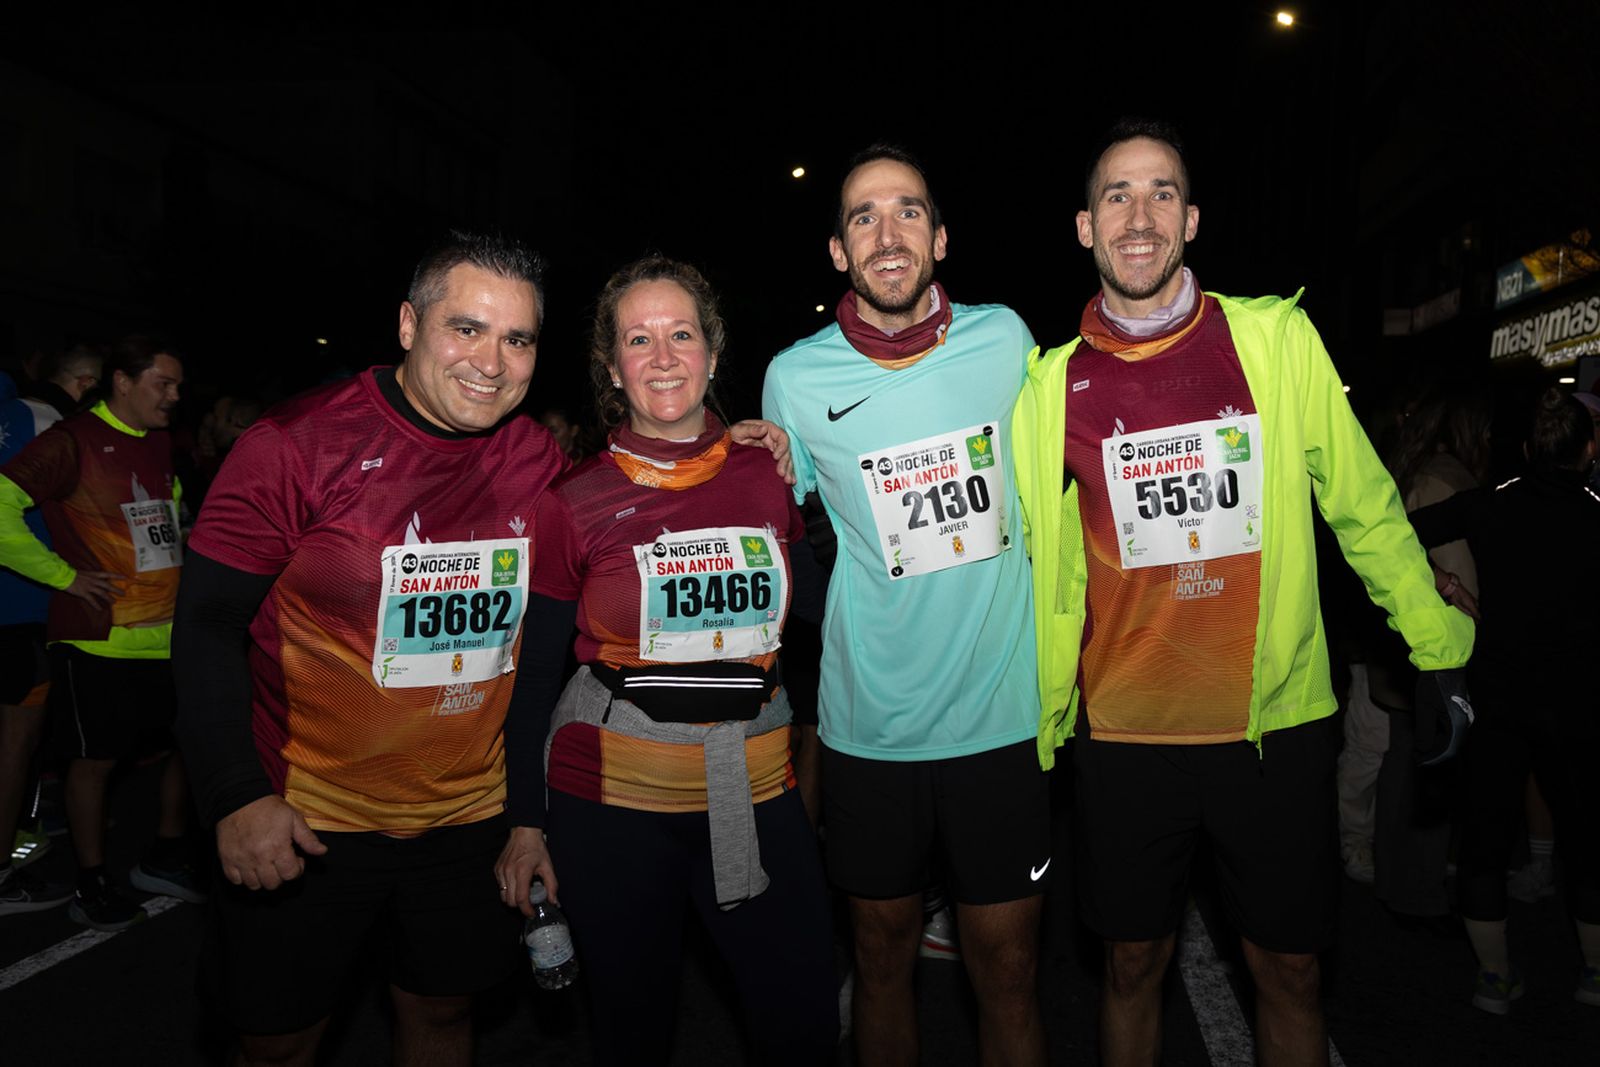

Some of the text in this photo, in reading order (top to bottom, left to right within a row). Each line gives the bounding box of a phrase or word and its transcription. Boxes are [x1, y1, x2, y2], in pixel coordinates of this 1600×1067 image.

[1489, 297, 1600, 359] masymas
[1120, 447, 1134, 457] 43
[1138, 438, 1202, 460] NOCHE DE
[896, 454, 937, 473] NOCHE
[940, 448, 955, 461] DE
[1122, 453, 1204, 480] SAN ANTÓN
[884, 462, 959, 493] SAN ANTÓN
[902, 475, 990, 530] 2130
[1135, 468, 1239, 520] 5530
[939, 521, 969, 536] JAVIER
[1177, 518, 1204, 528] Víctor
[670, 542, 730, 557] NOCHE DE
[402, 558, 417, 569] 43
[419, 557, 480, 573] NOCHE DE
[657, 555, 734, 575] SAN ANTÓN
[400, 571, 480, 593] SAN ANTÓN
[1178, 567, 1204, 582] SAN
[660, 571, 771, 618] 13466
[1175, 576, 1224, 595] ANTÓN
[398, 590, 512, 639] 13682
[702, 617, 735, 629] Rosalía
[430, 637, 485, 651] José Manuel
[439, 689, 485, 709] ANTÓN
[444, 683, 473, 696] SAN
